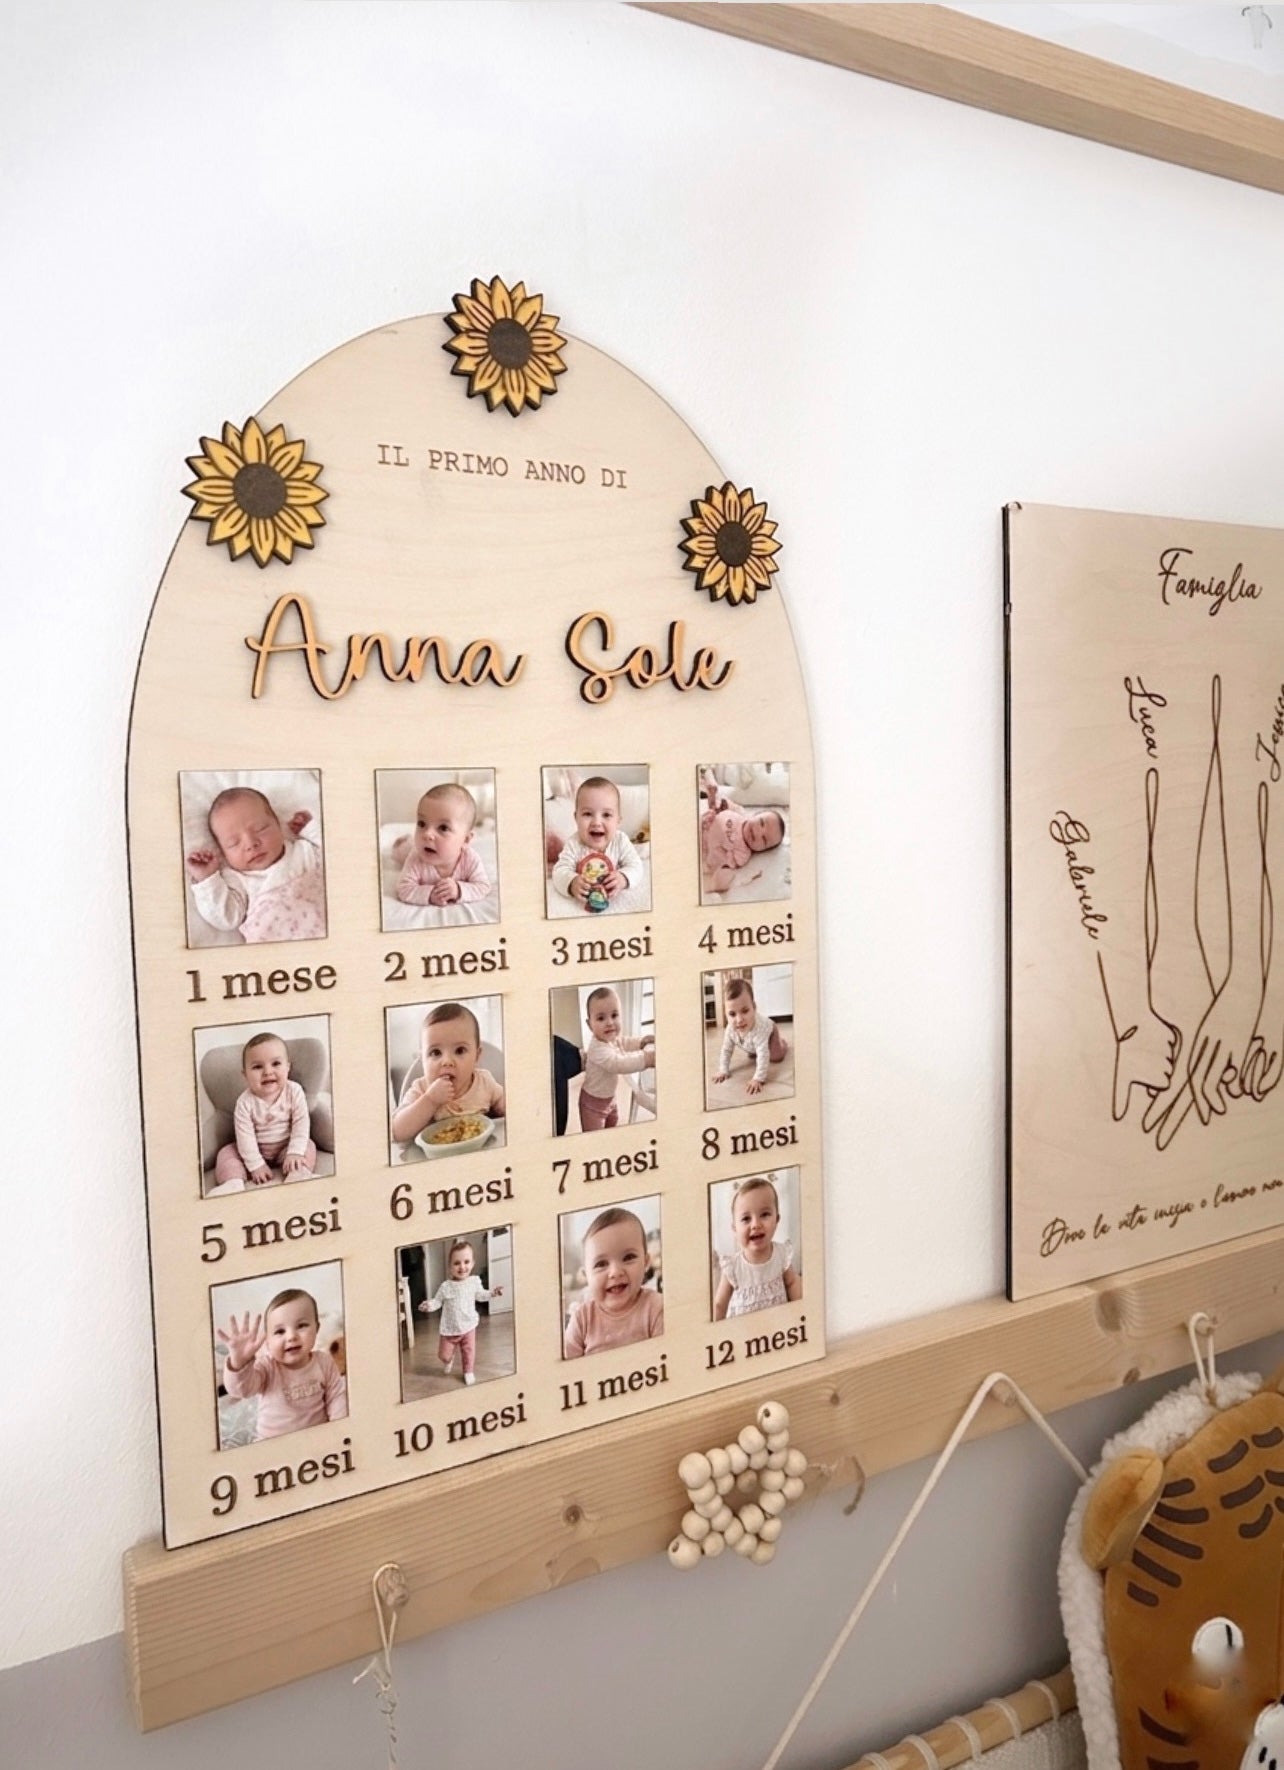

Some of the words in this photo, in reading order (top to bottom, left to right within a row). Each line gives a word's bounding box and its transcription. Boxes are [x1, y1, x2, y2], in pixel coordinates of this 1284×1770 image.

[378, 444, 409, 466] IL
[428, 450, 508, 477] PRIMO
[525, 460, 585, 484] ANNO
[601, 468, 626, 488] DI
[1158, 548, 1262, 616] Famiglia
[245, 593, 529, 700] Anna
[565, 611, 739, 704] Sole
[1124, 676, 1167, 758] Luca
[1050, 811, 1107, 939] Gabriele
[384, 952, 407, 982] 2
[421, 938, 509, 978] mesi
[552, 937, 569, 965] 3
[577, 926, 653, 963] mesi
[698, 925, 717, 953] 4
[727, 913, 794, 948] mesi
[186, 970, 206, 1003] 1
[222, 965, 336, 1000] mese
[702, 1127, 720, 1160] 8
[731, 1116, 798, 1155] mesi
[390, 1184, 413, 1220] 6
[428, 1167, 514, 1214] mesi
[553, 1159, 571, 1194] 7
[583, 1139, 659, 1183] mesi
[201, 1223, 226, 1263] 5
[242, 1197, 341, 1248] mesi
[1094, 1214, 1110, 1239] la
[706, 1340, 735, 1370] 12
[745, 1316, 808, 1358] mesi
[560, 1381, 587, 1411] 11
[598, 1354, 669, 1400] mesi
[394, 1423, 433, 1457] 10
[447, 1393, 527, 1443] mesi
[211, 1475, 237, 1516] 9
[254, 1437, 355, 1499] mesi
